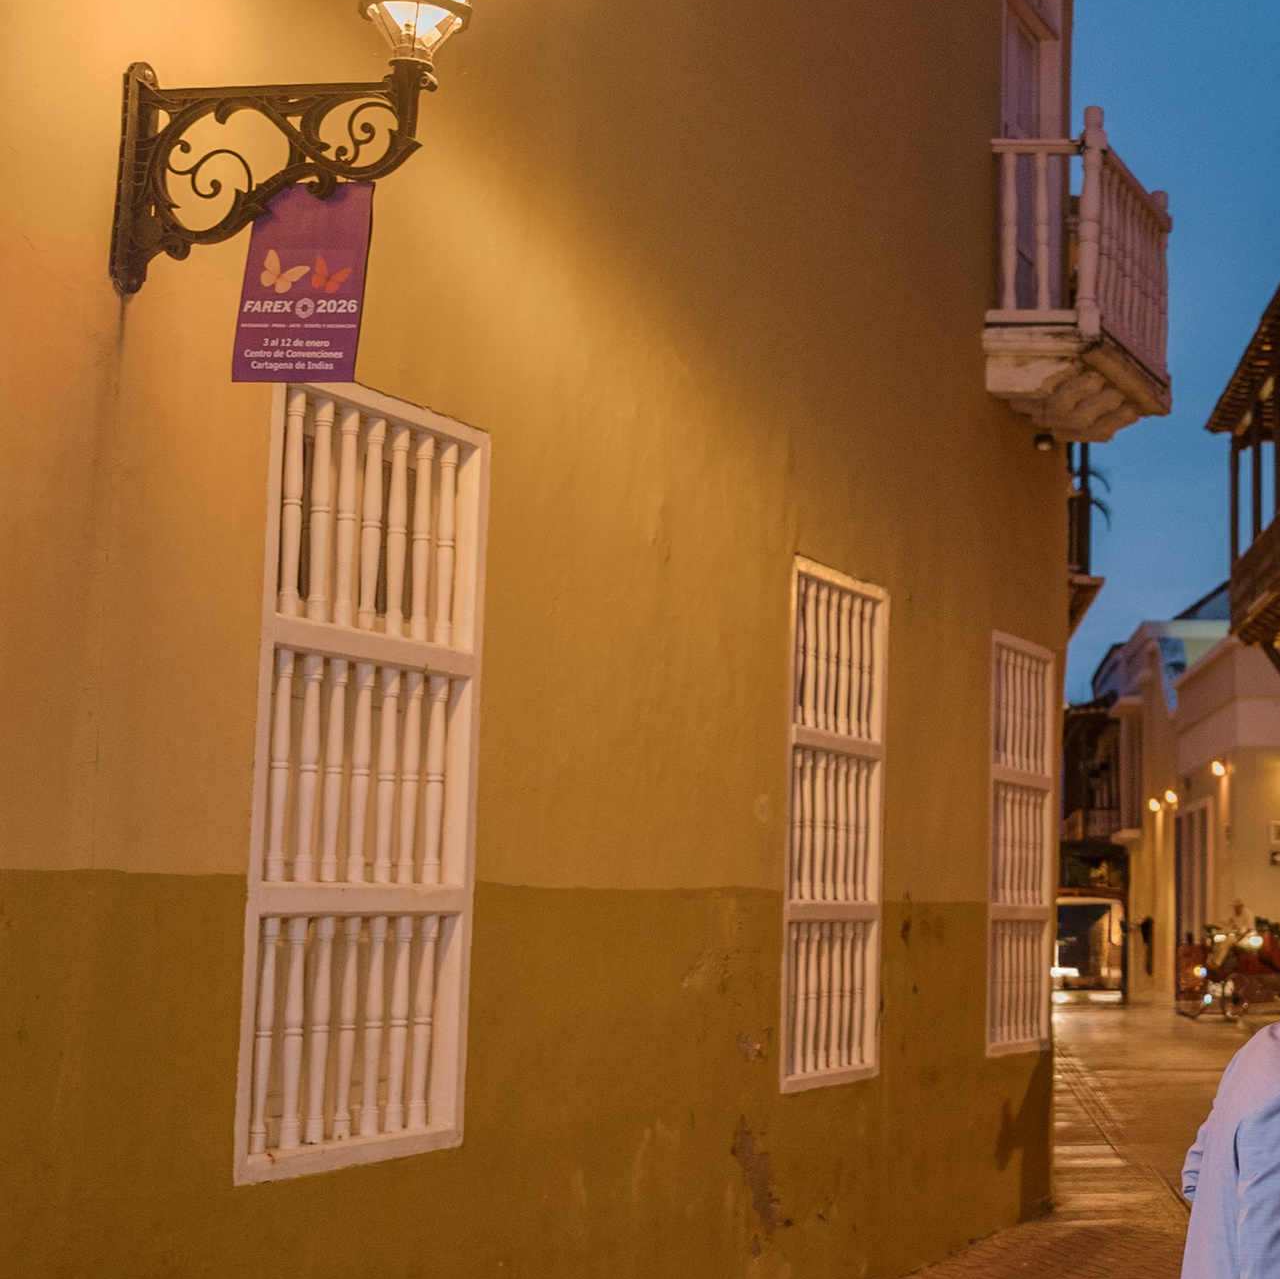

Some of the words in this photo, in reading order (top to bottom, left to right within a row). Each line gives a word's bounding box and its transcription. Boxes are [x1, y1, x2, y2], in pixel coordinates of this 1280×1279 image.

[243, 300, 294, 313] FAREX
[316, 299, 358, 313] 2026
[263, 338, 269, 347] 3
[270, 338, 279, 347] al
[280, 338, 292, 347] 12
[292, 338, 304, 347] de
[244, 349, 272, 358] Centro
[273, 349, 285, 358] de
[285, 349, 344, 359] Convenciones
[251, 361, 293, 372] Cartagena
[294, 361, 306, 370] de
[307, 361, 334, 370] Indias
